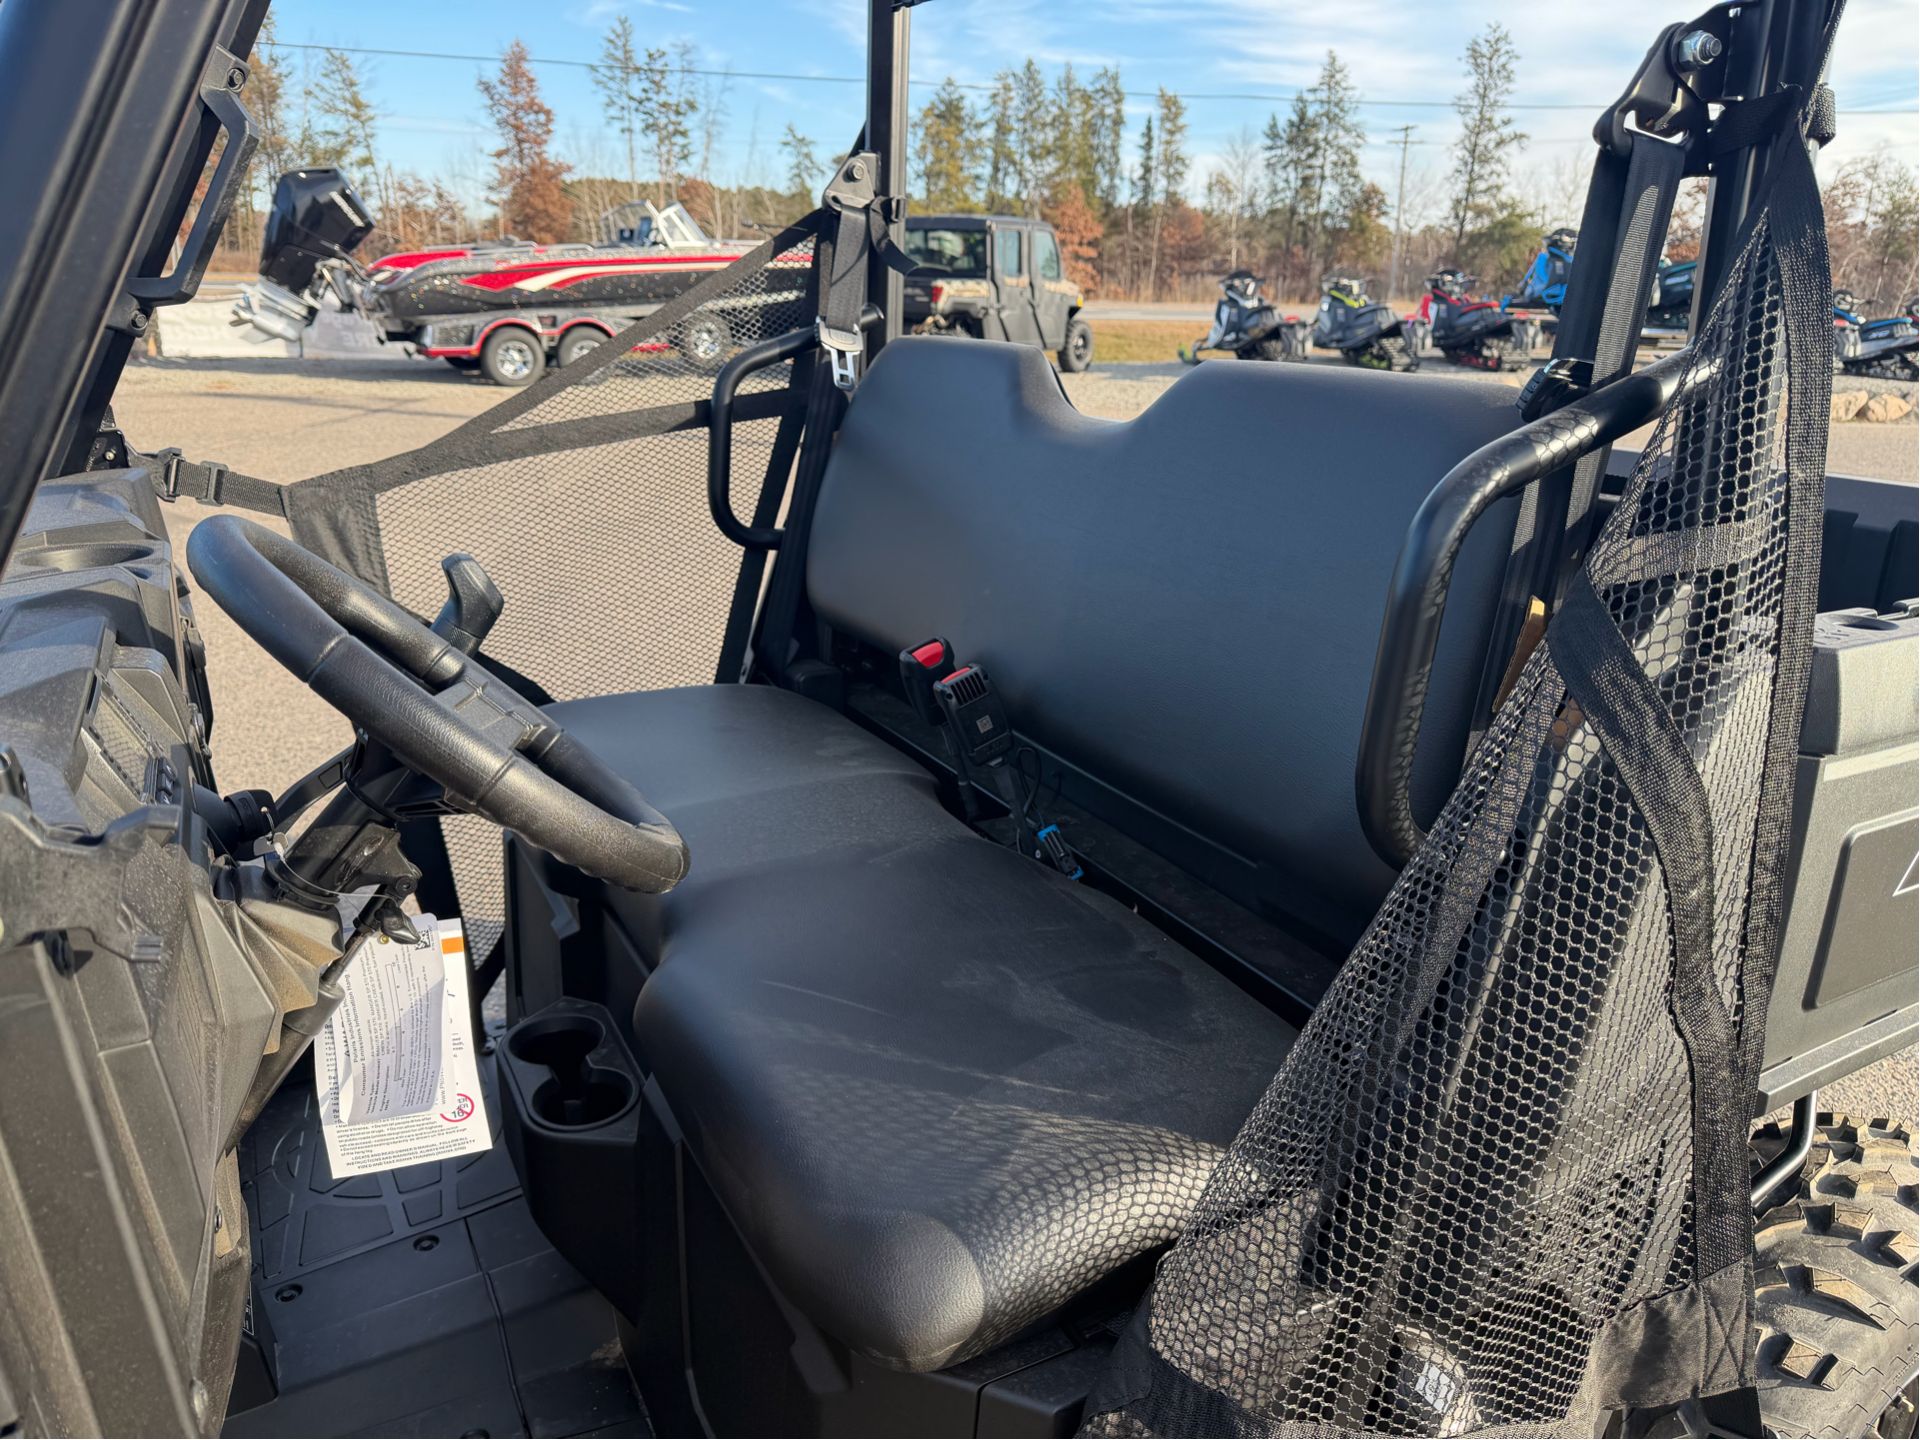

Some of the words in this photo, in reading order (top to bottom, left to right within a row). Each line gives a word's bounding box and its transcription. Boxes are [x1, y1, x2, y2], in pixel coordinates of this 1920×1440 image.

[345, 1008, 354, 1038] Industries
[348, 991, 360, 1026] Information
[356, 1028, 365, 1060] Emissions
[451, 1109, 464, 1118] 16
